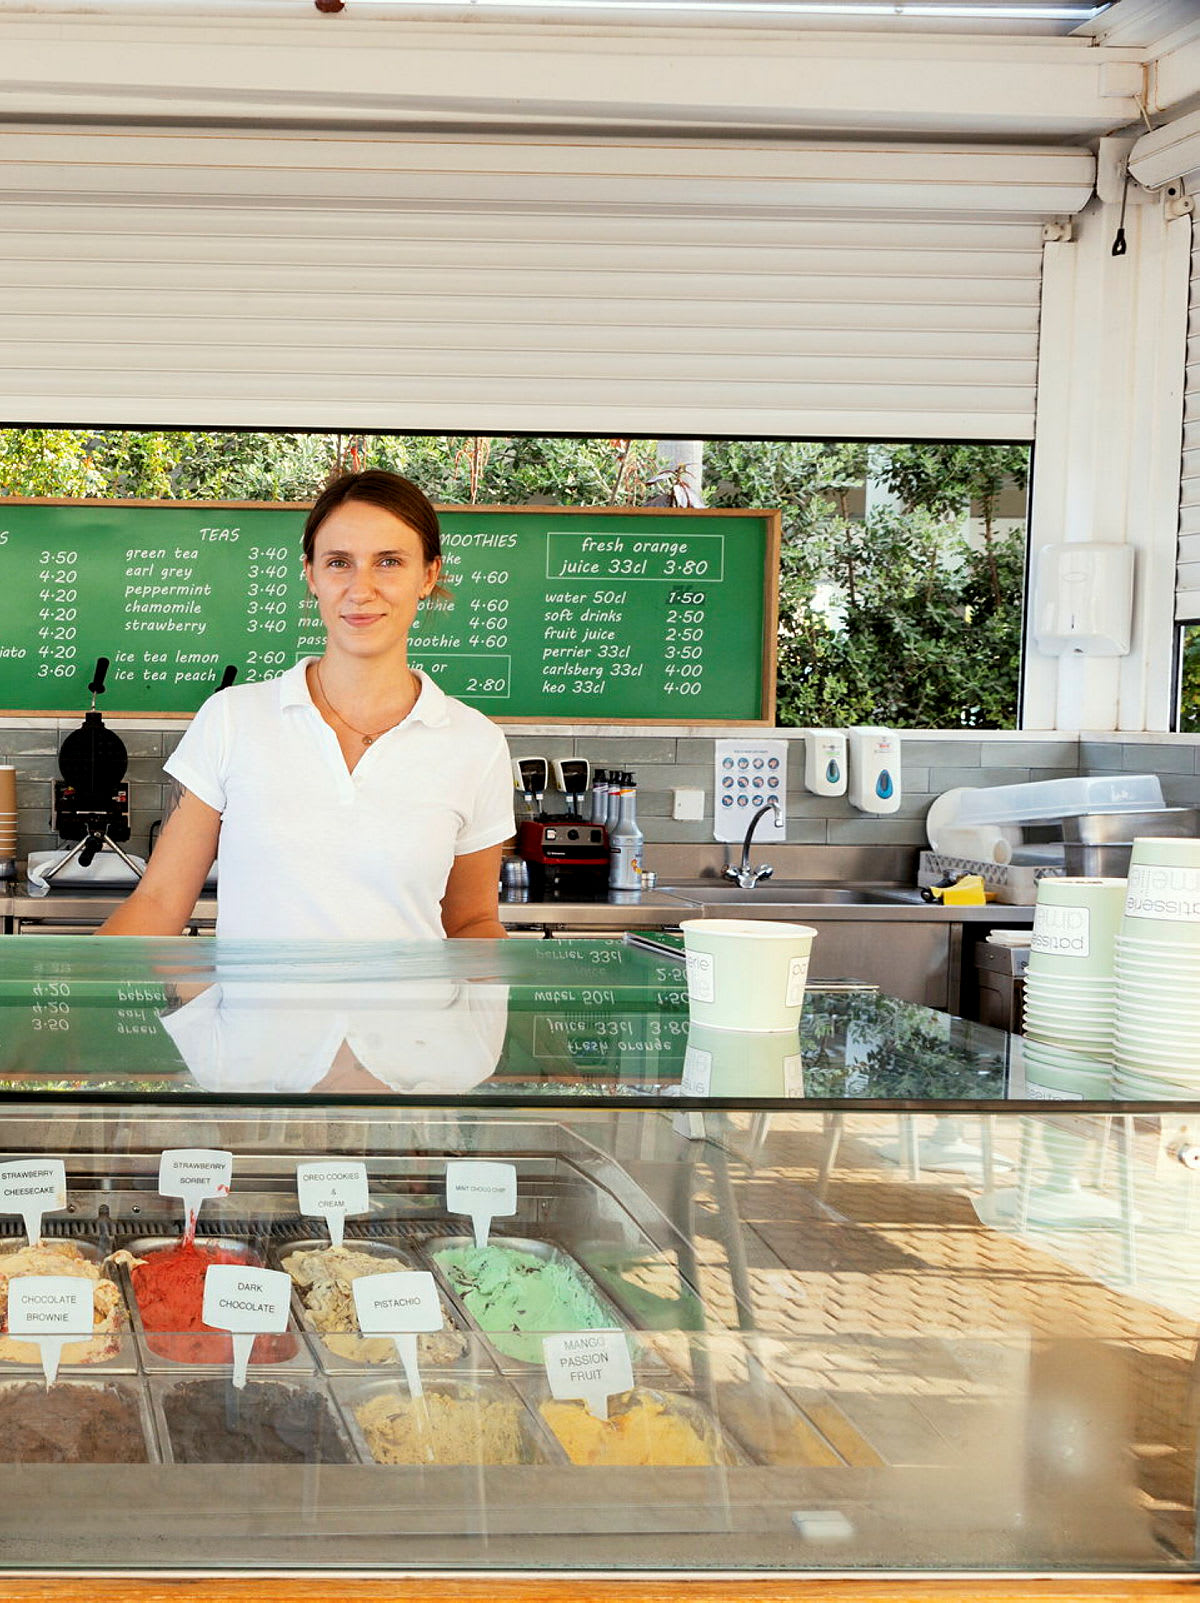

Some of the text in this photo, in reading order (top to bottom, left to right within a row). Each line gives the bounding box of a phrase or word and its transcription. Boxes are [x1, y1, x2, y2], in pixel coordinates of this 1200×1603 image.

[200, 528, 240, 541] TEAS
[582, 537, 687, 556] fresh orange
[127, 550, 165, 561] green
[175, 548, 198, 559] tea
[126, 564, 153, 576] earl
[161, 568, 192, 580] grey
[559, 560, 599, 576] juice
[608, 559, 647, 573] 33cl
[125, 584, 211, 597] peppermint
[546, 593, 587, 603] water
[593, 591, 626, 603] 50cl
[126, 600, 201, 613] chamomile
[545, 609, 573, 621] soft
[581, 608, 622, 622] drinks
[125, 619, 206, 634] strawberry
[545, 626, 576, 639] fruit
[582, 628, 615, 642] juice
[116, 651, 134, 662] ice
[144, 651, 167, 662] tea
[176, 650, 218, 663] lemon
[543, 646, 591, 660] perrier
[598, 645, 630, 658] 33cl
[432, 664, 447, 672] or
[543, 663, 603, 679] carlsberg
[610, 664, 642, 676] 33cl
[115, 668, 134, 680] ice
[144, 669, 167, 680] tea
[175, 669, 215, 683] peach
[542, 680, 565, 693] keo
[572, 681, 605, 693] 33cl
[173, 1162, 225, 1171] STRAWBERRY
[2, 1170, 53, 1179] STRAWBERRY
[180, 1177, 210, 1185] SORBET
[303, 1172, 359, 1182] OREO COOKIES
[4, 1187, 54, 1196] CHEESECAKE
[318, 1200, 344, 1208] CREAM
[238, 1283, 262, 1292] DARK
[22, 1295, 76, 1304] CHOCOLATE
[219, 1299, 274, 1313] CHOCOLATE
[374, 1297, 420, 1308] PISTACHIO
[27, 1312, 68, 1322] BROWNIE
[564, 1338, 605, 1349] MANGO
[560, 1353, 608, 1367] PASSION
[571, 1369, 601, 1381] FRUIT
